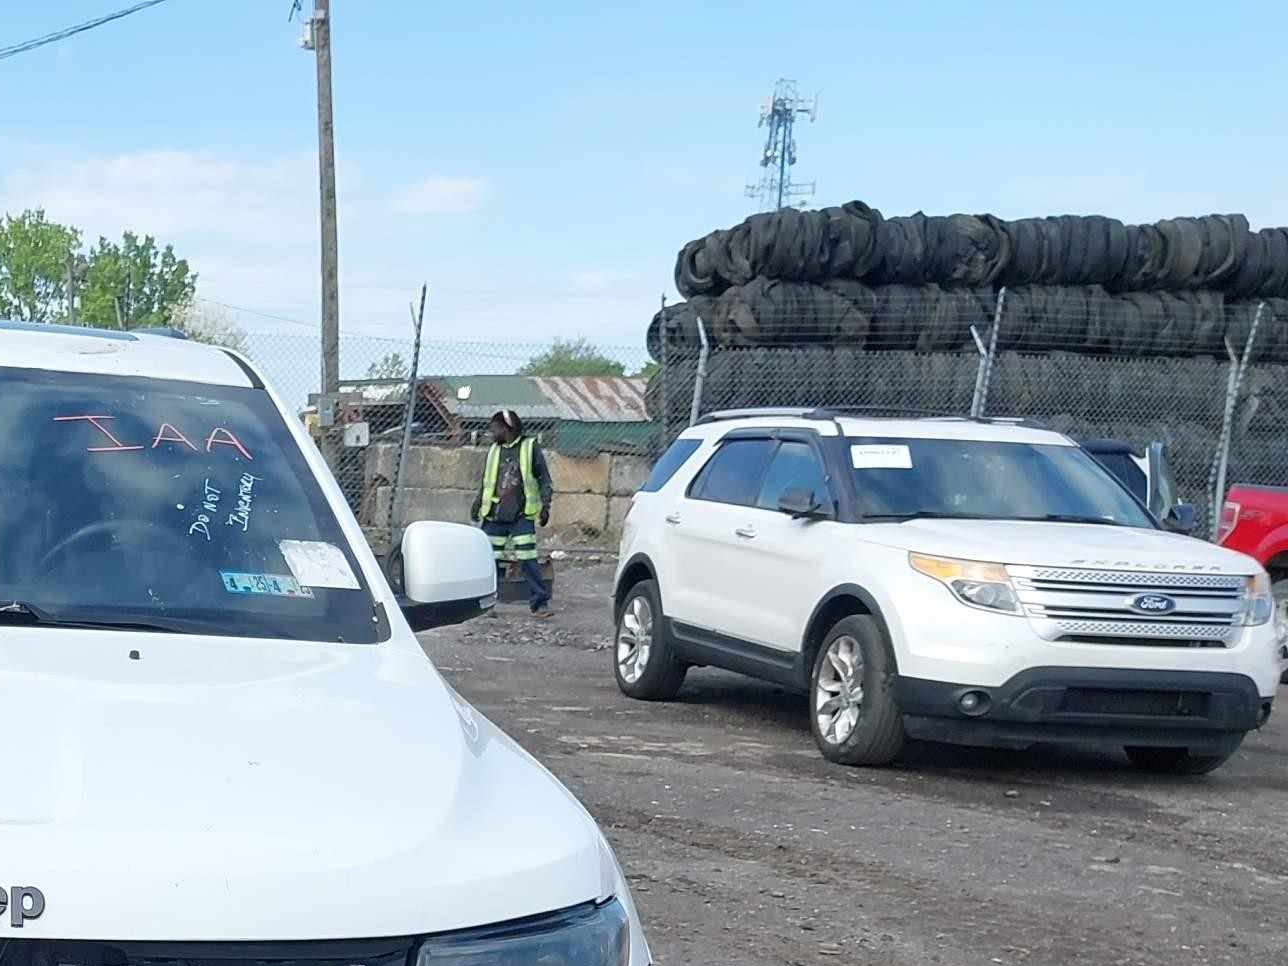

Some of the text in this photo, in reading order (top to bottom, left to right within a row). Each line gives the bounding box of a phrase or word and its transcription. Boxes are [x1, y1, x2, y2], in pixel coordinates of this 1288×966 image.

[53, 415, 254, 460] IAA
[189, 478, 221, 541] DO NOT
[1140, 596, 1168, 610] Ford
